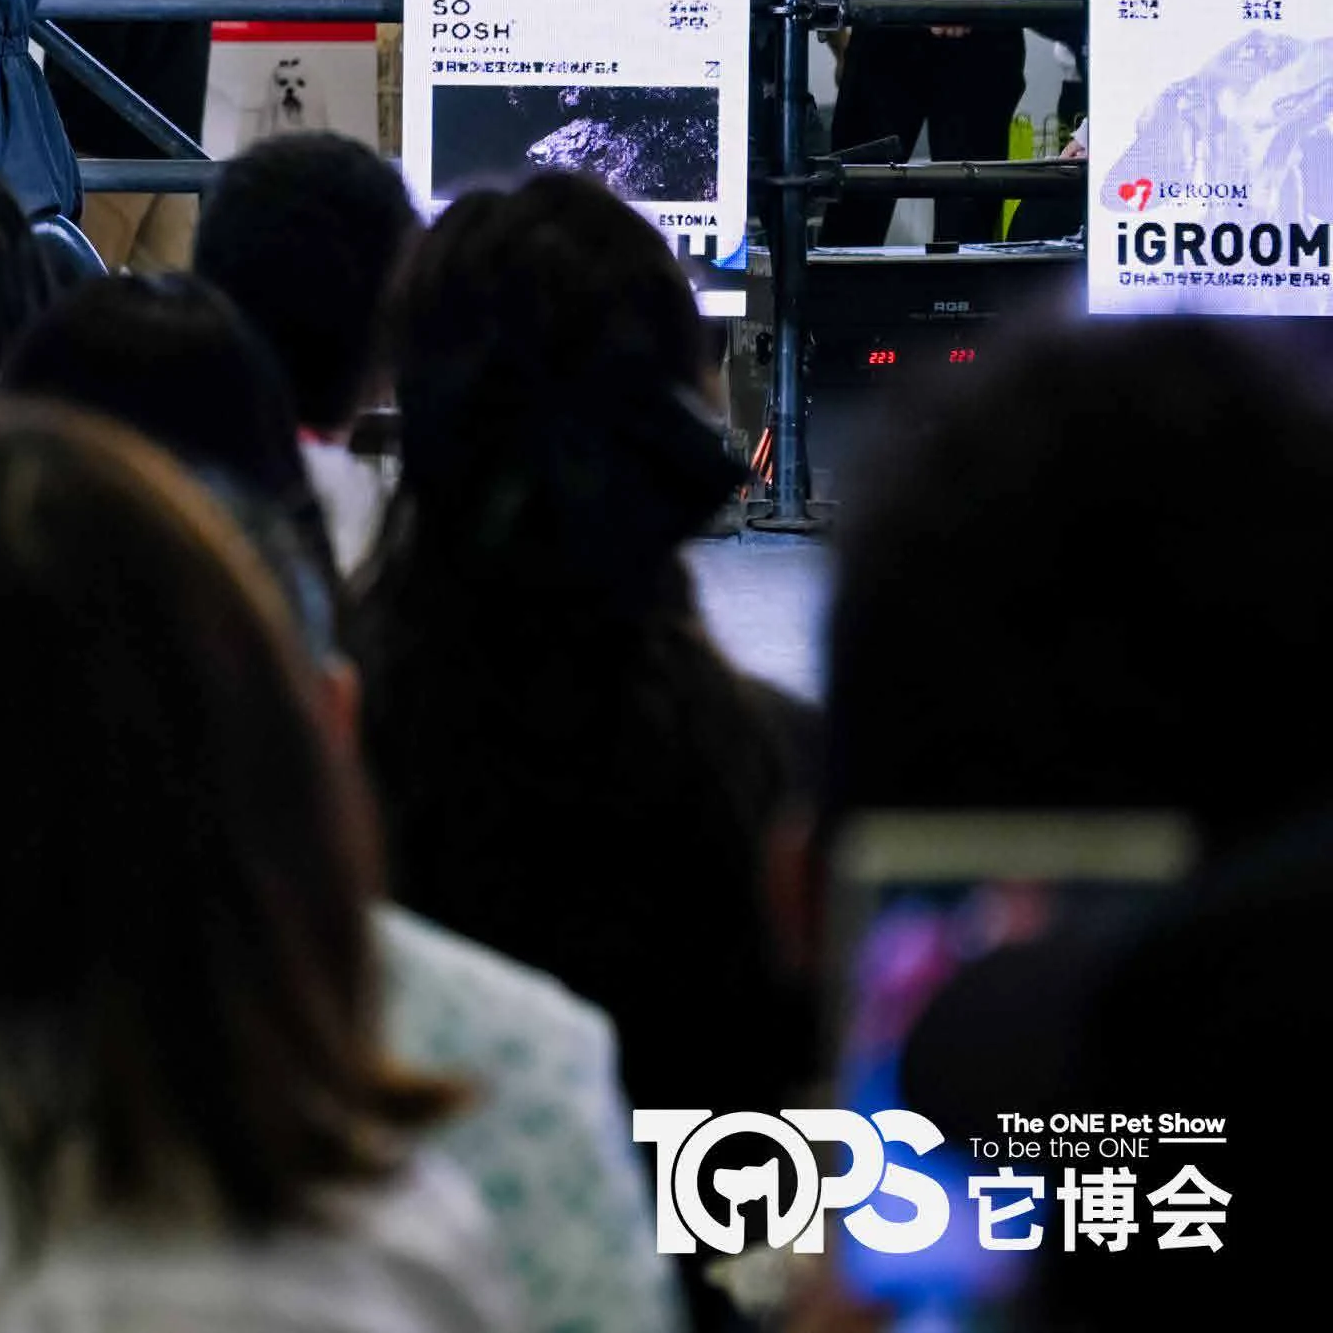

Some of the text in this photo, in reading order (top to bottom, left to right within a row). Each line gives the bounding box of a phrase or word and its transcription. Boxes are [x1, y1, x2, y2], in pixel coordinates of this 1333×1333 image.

[432, 23, 510, 41] POSH
[659, 214, 718, 227] ESTONIA
[1117, 222, 1331, 267] iGROOM
